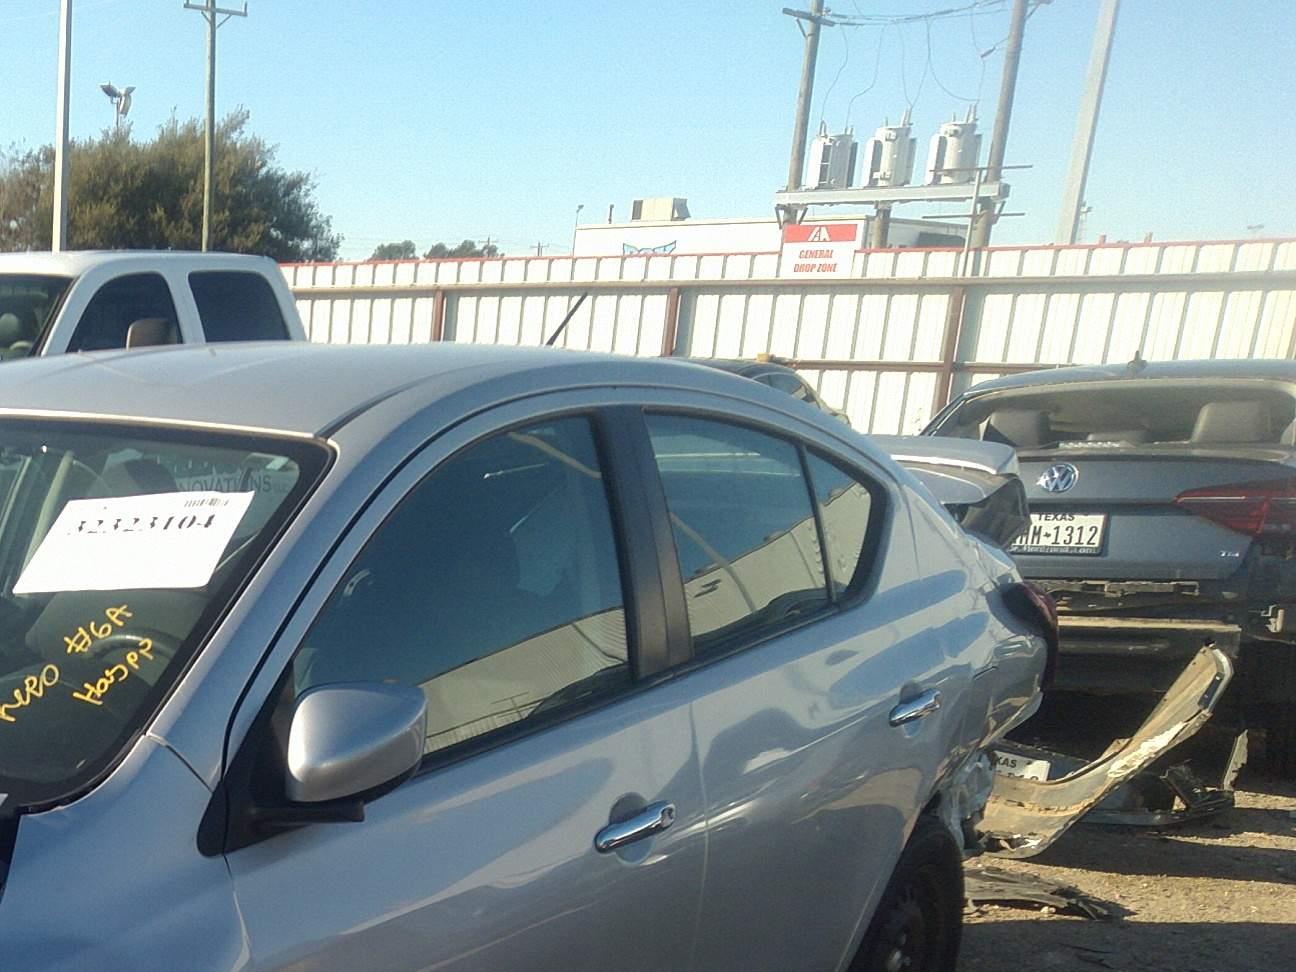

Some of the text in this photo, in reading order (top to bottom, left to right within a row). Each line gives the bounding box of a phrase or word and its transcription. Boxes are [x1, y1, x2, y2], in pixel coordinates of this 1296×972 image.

[799, 250, 833, 258] GENERAL
[794, 263, 838, 273] DROP ZONE
[1038, 513, 1075, 521] TEXAS
